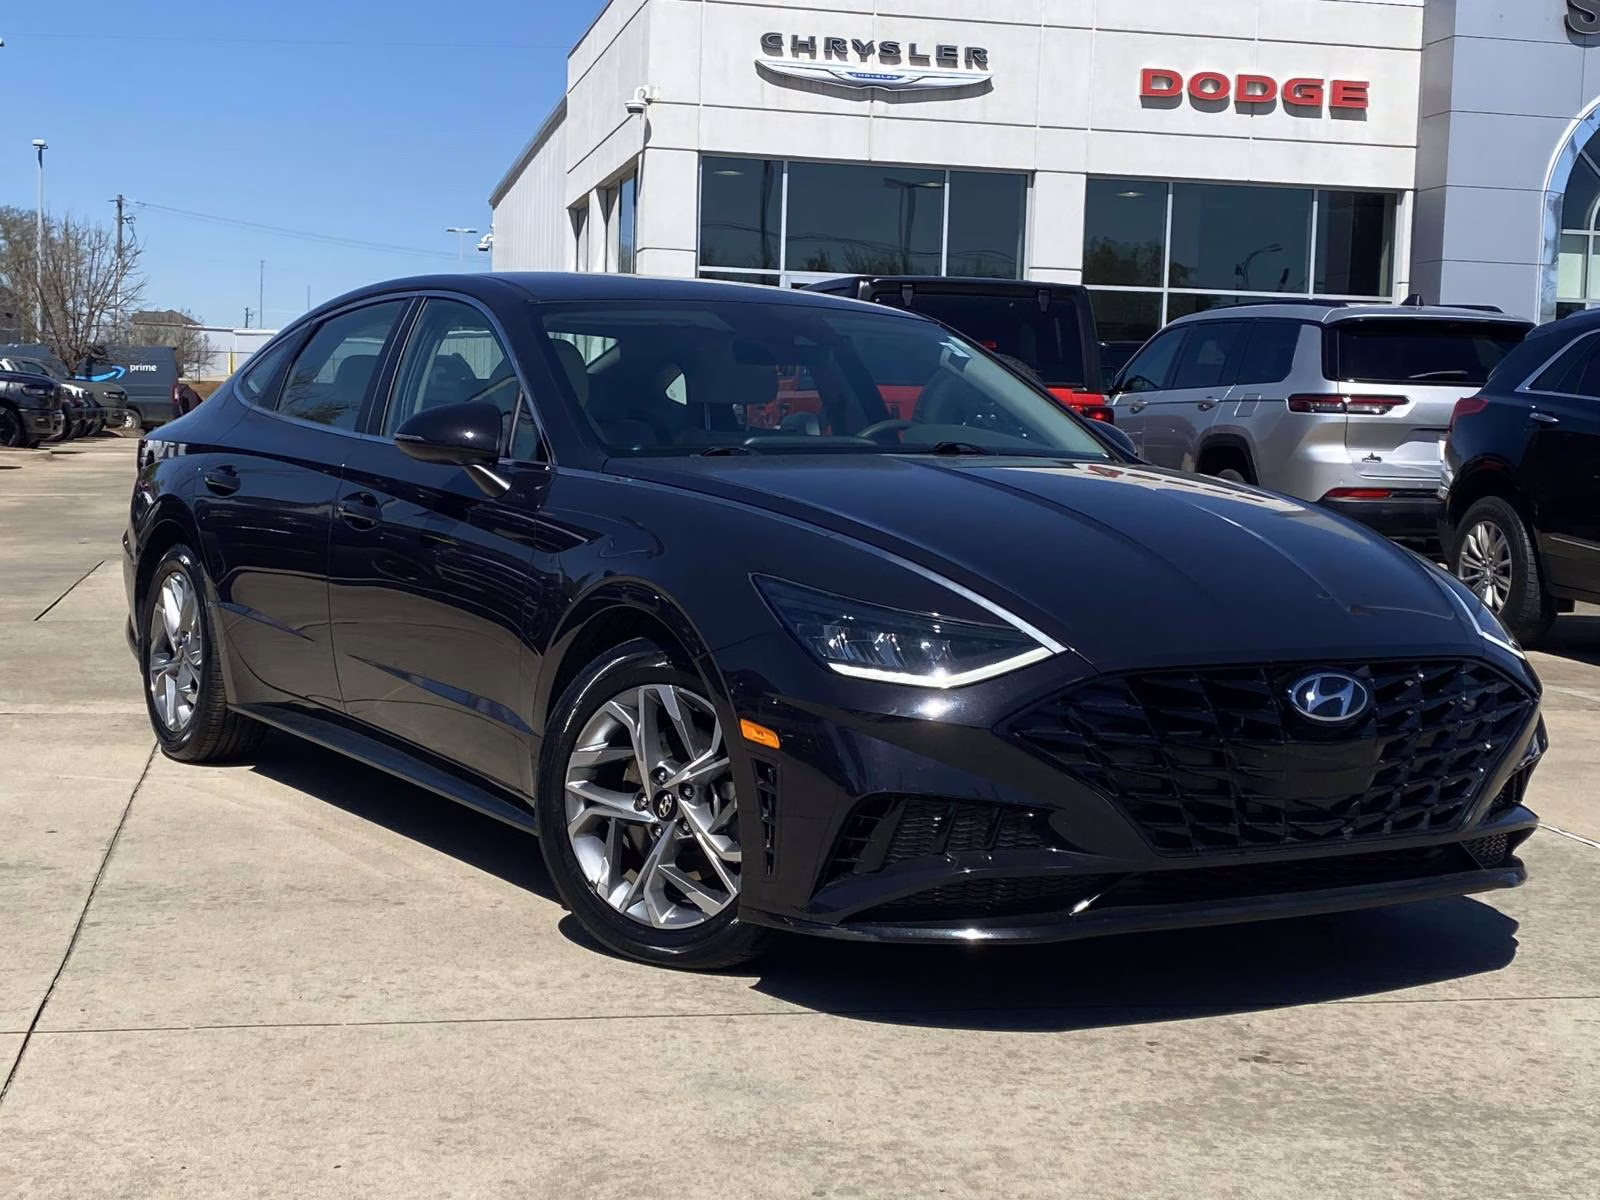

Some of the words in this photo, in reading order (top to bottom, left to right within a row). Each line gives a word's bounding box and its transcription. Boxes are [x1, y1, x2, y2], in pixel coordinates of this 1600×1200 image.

[760, 32, 989, 69] CHRYSLER
[1140, 68, 1369, 120] DODGE
[130, 363, 157, 373] prime
